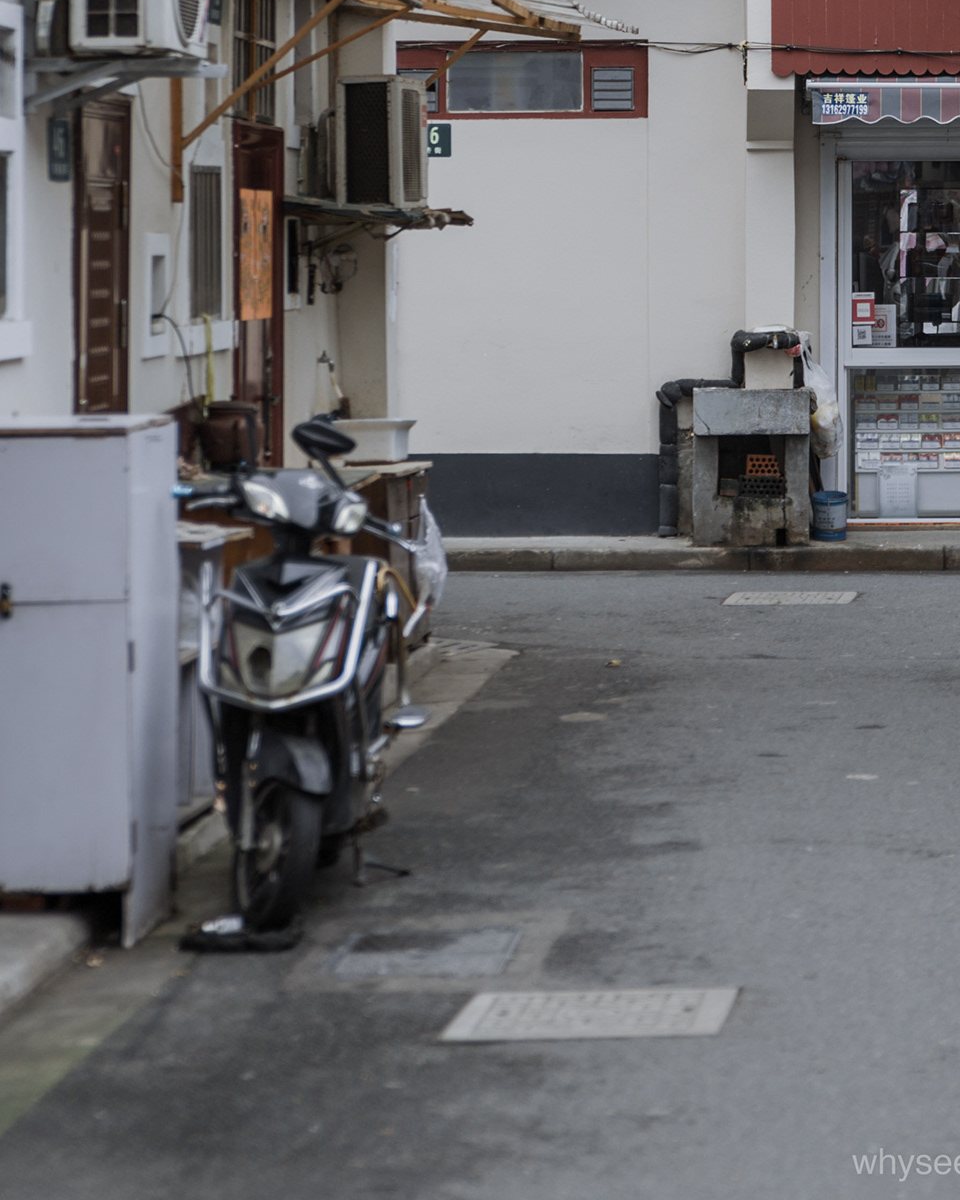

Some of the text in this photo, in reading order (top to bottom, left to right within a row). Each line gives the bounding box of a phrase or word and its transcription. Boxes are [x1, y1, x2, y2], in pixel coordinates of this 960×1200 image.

[823, 93, 867, 104] 吉祥篷业
[822, 104, 868, 115] 13162977199
